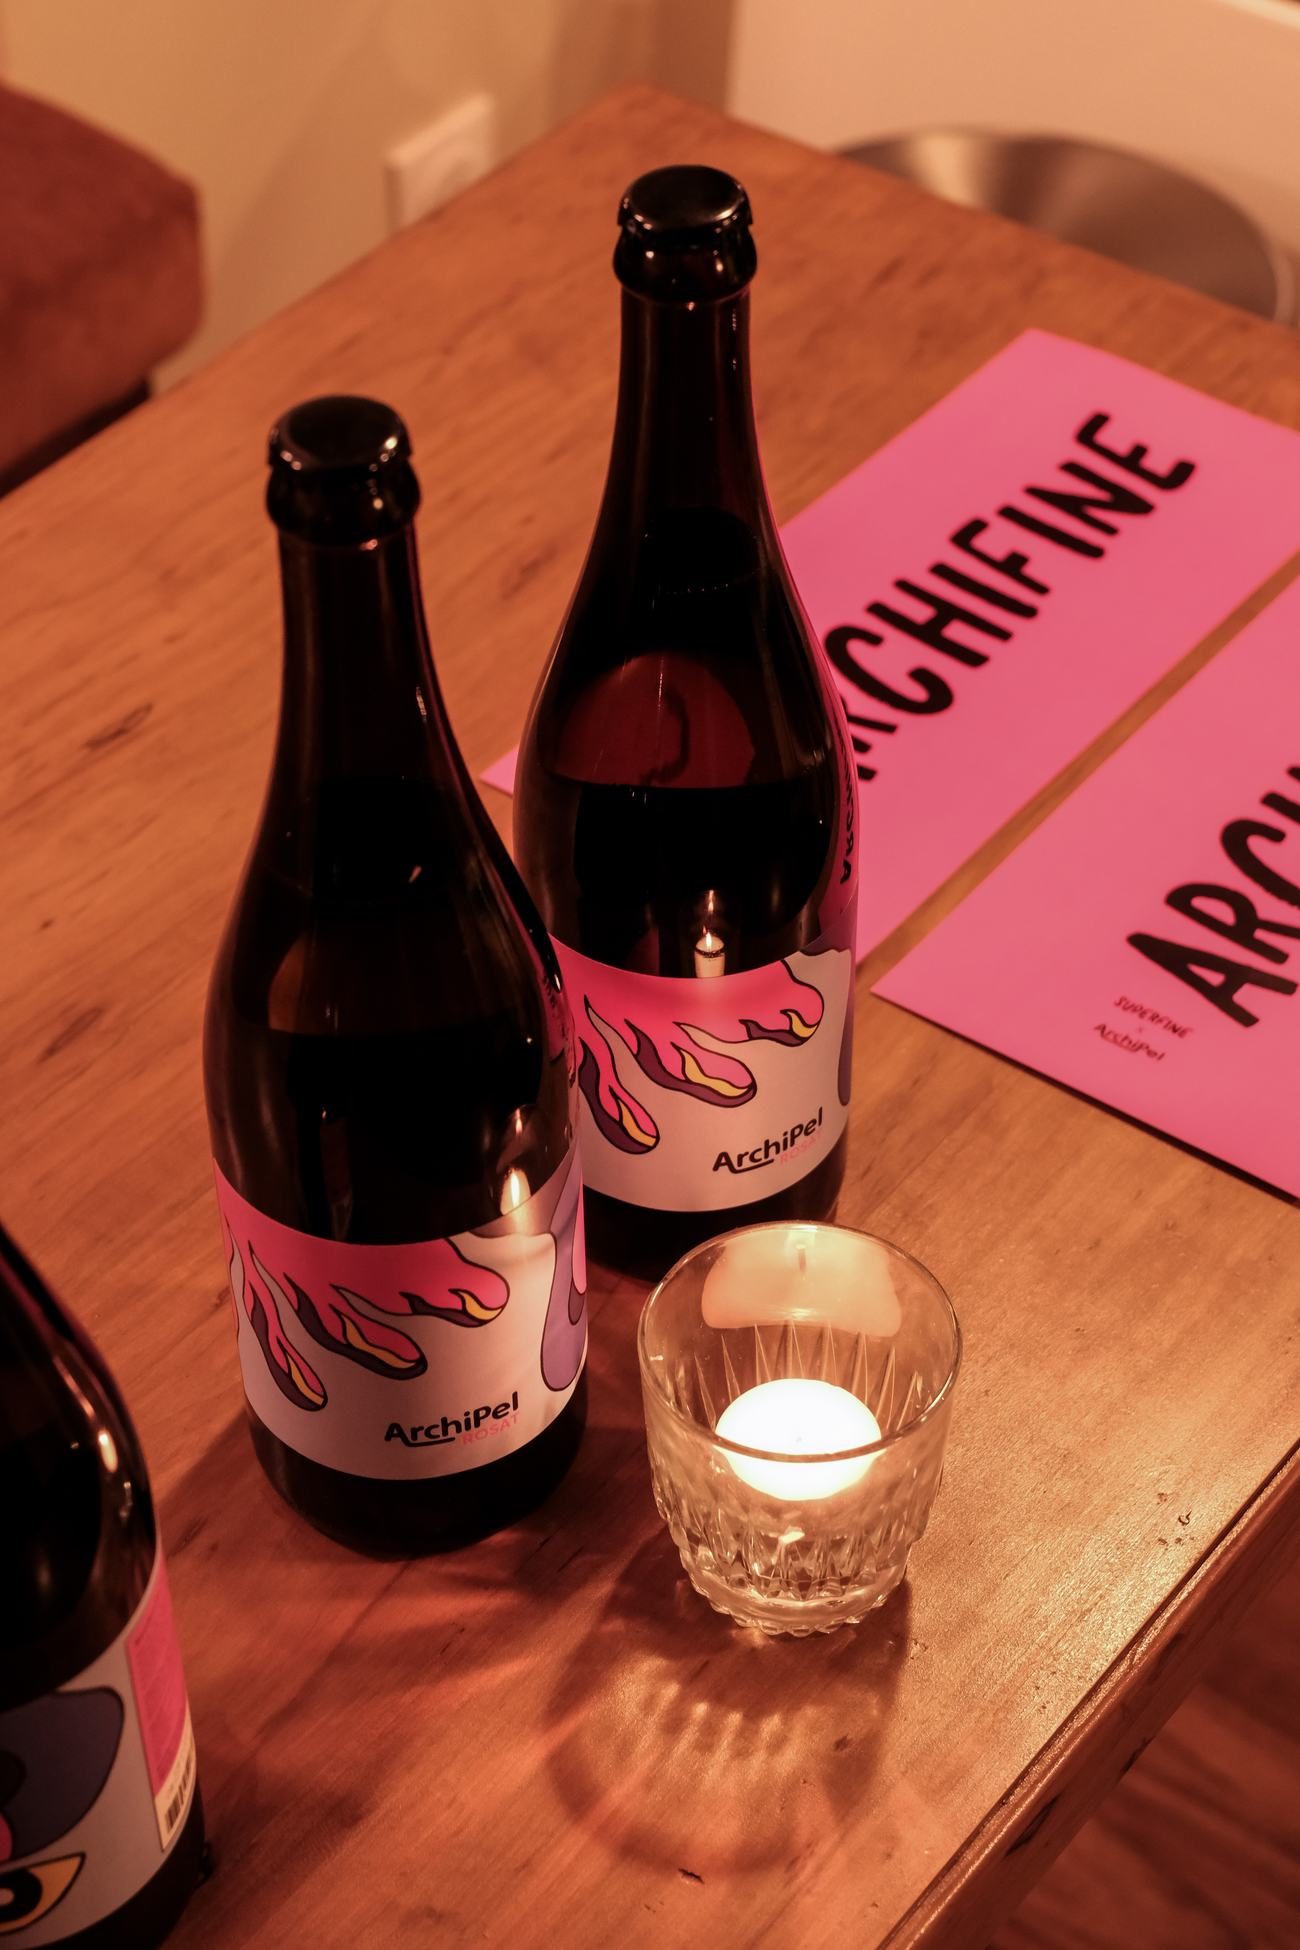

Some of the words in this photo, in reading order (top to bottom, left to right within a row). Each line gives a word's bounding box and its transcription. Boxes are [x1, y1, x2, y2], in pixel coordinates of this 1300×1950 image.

[825, 412, 1197, 782] CHIFINE
[1094, 1023, 1166, 1061] ArchiPel
[1114, 995, 1193, 1039] SUPERFINE
[712, 1106, 824, 1174] ArchiPel
[384, 1391, 519, 1448] ArchiPel
